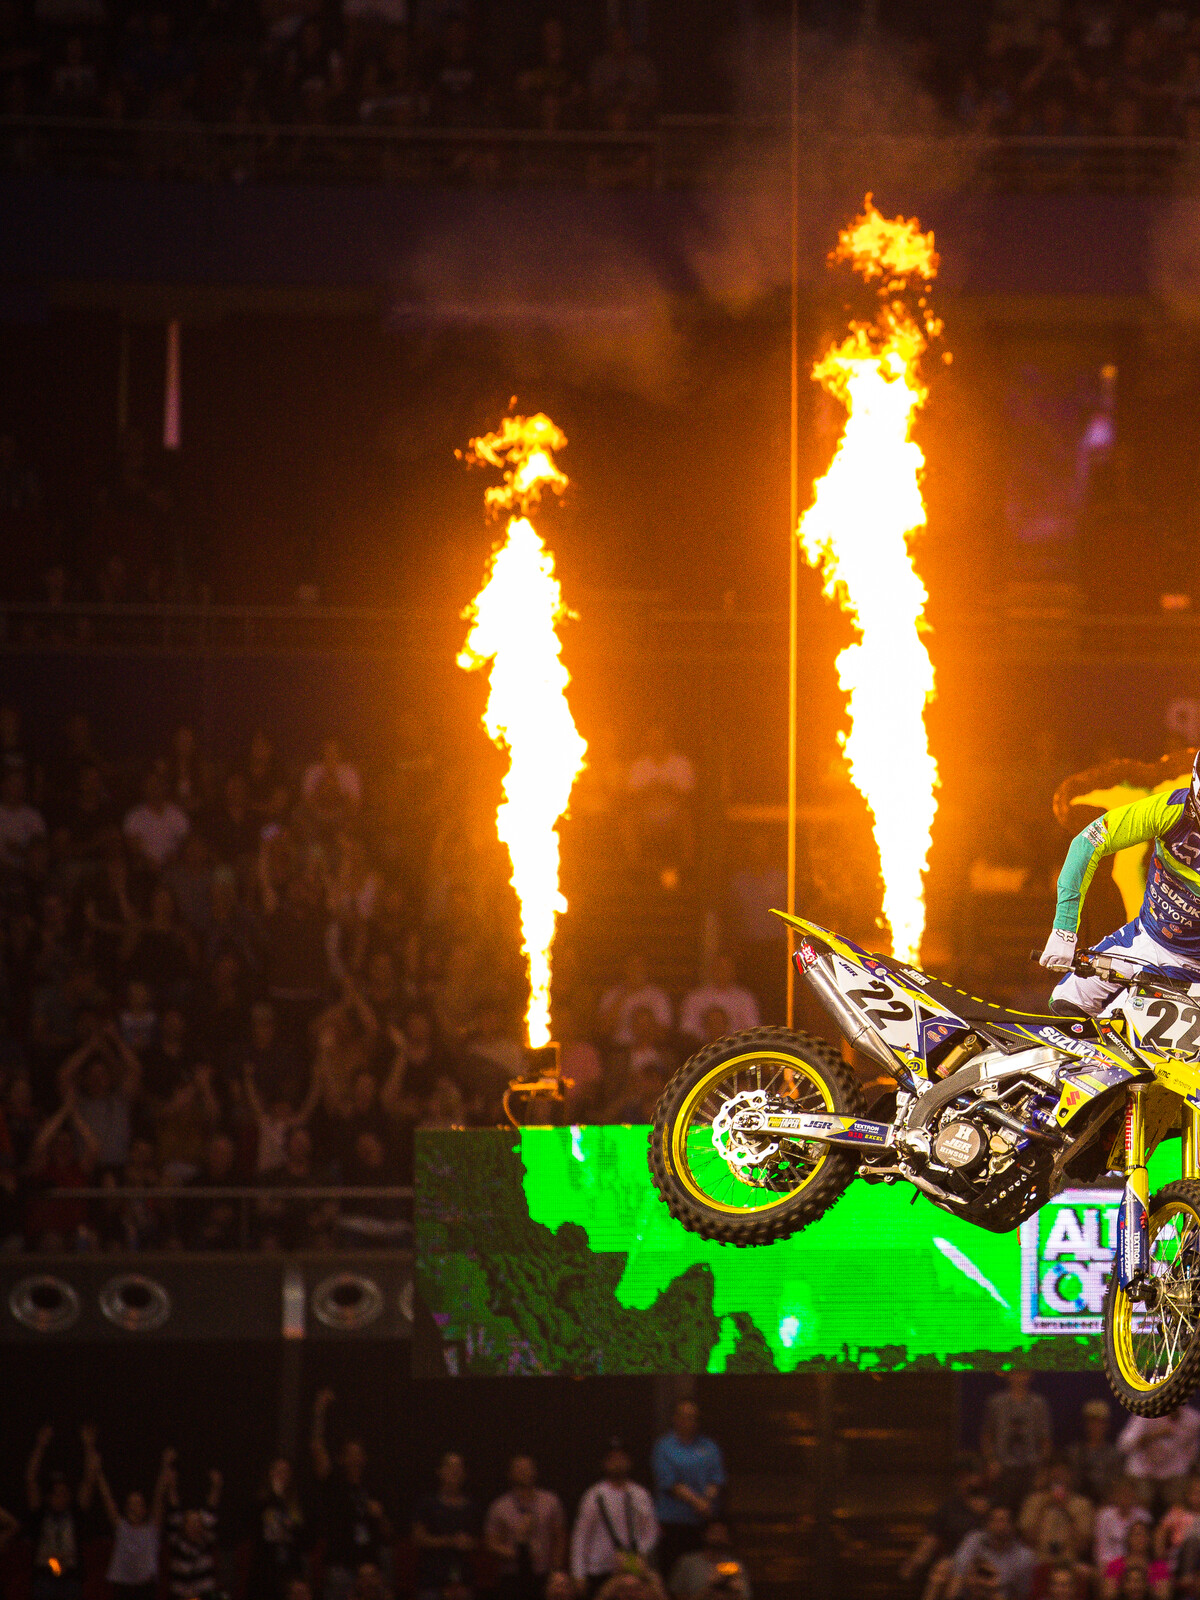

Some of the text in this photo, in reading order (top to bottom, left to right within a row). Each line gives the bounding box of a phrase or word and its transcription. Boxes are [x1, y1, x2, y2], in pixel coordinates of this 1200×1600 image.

[1157, 895, 1193, 928] TOYOTA
[839, 961, 859, 977] JGR
[845, 980, 913, 1031] 22
[1038, 1026, 1095, 1064] SUZUKI
[804, 1120, 833, 1129] JGR
[854, 1123, 879, 1131] TEXTRON
